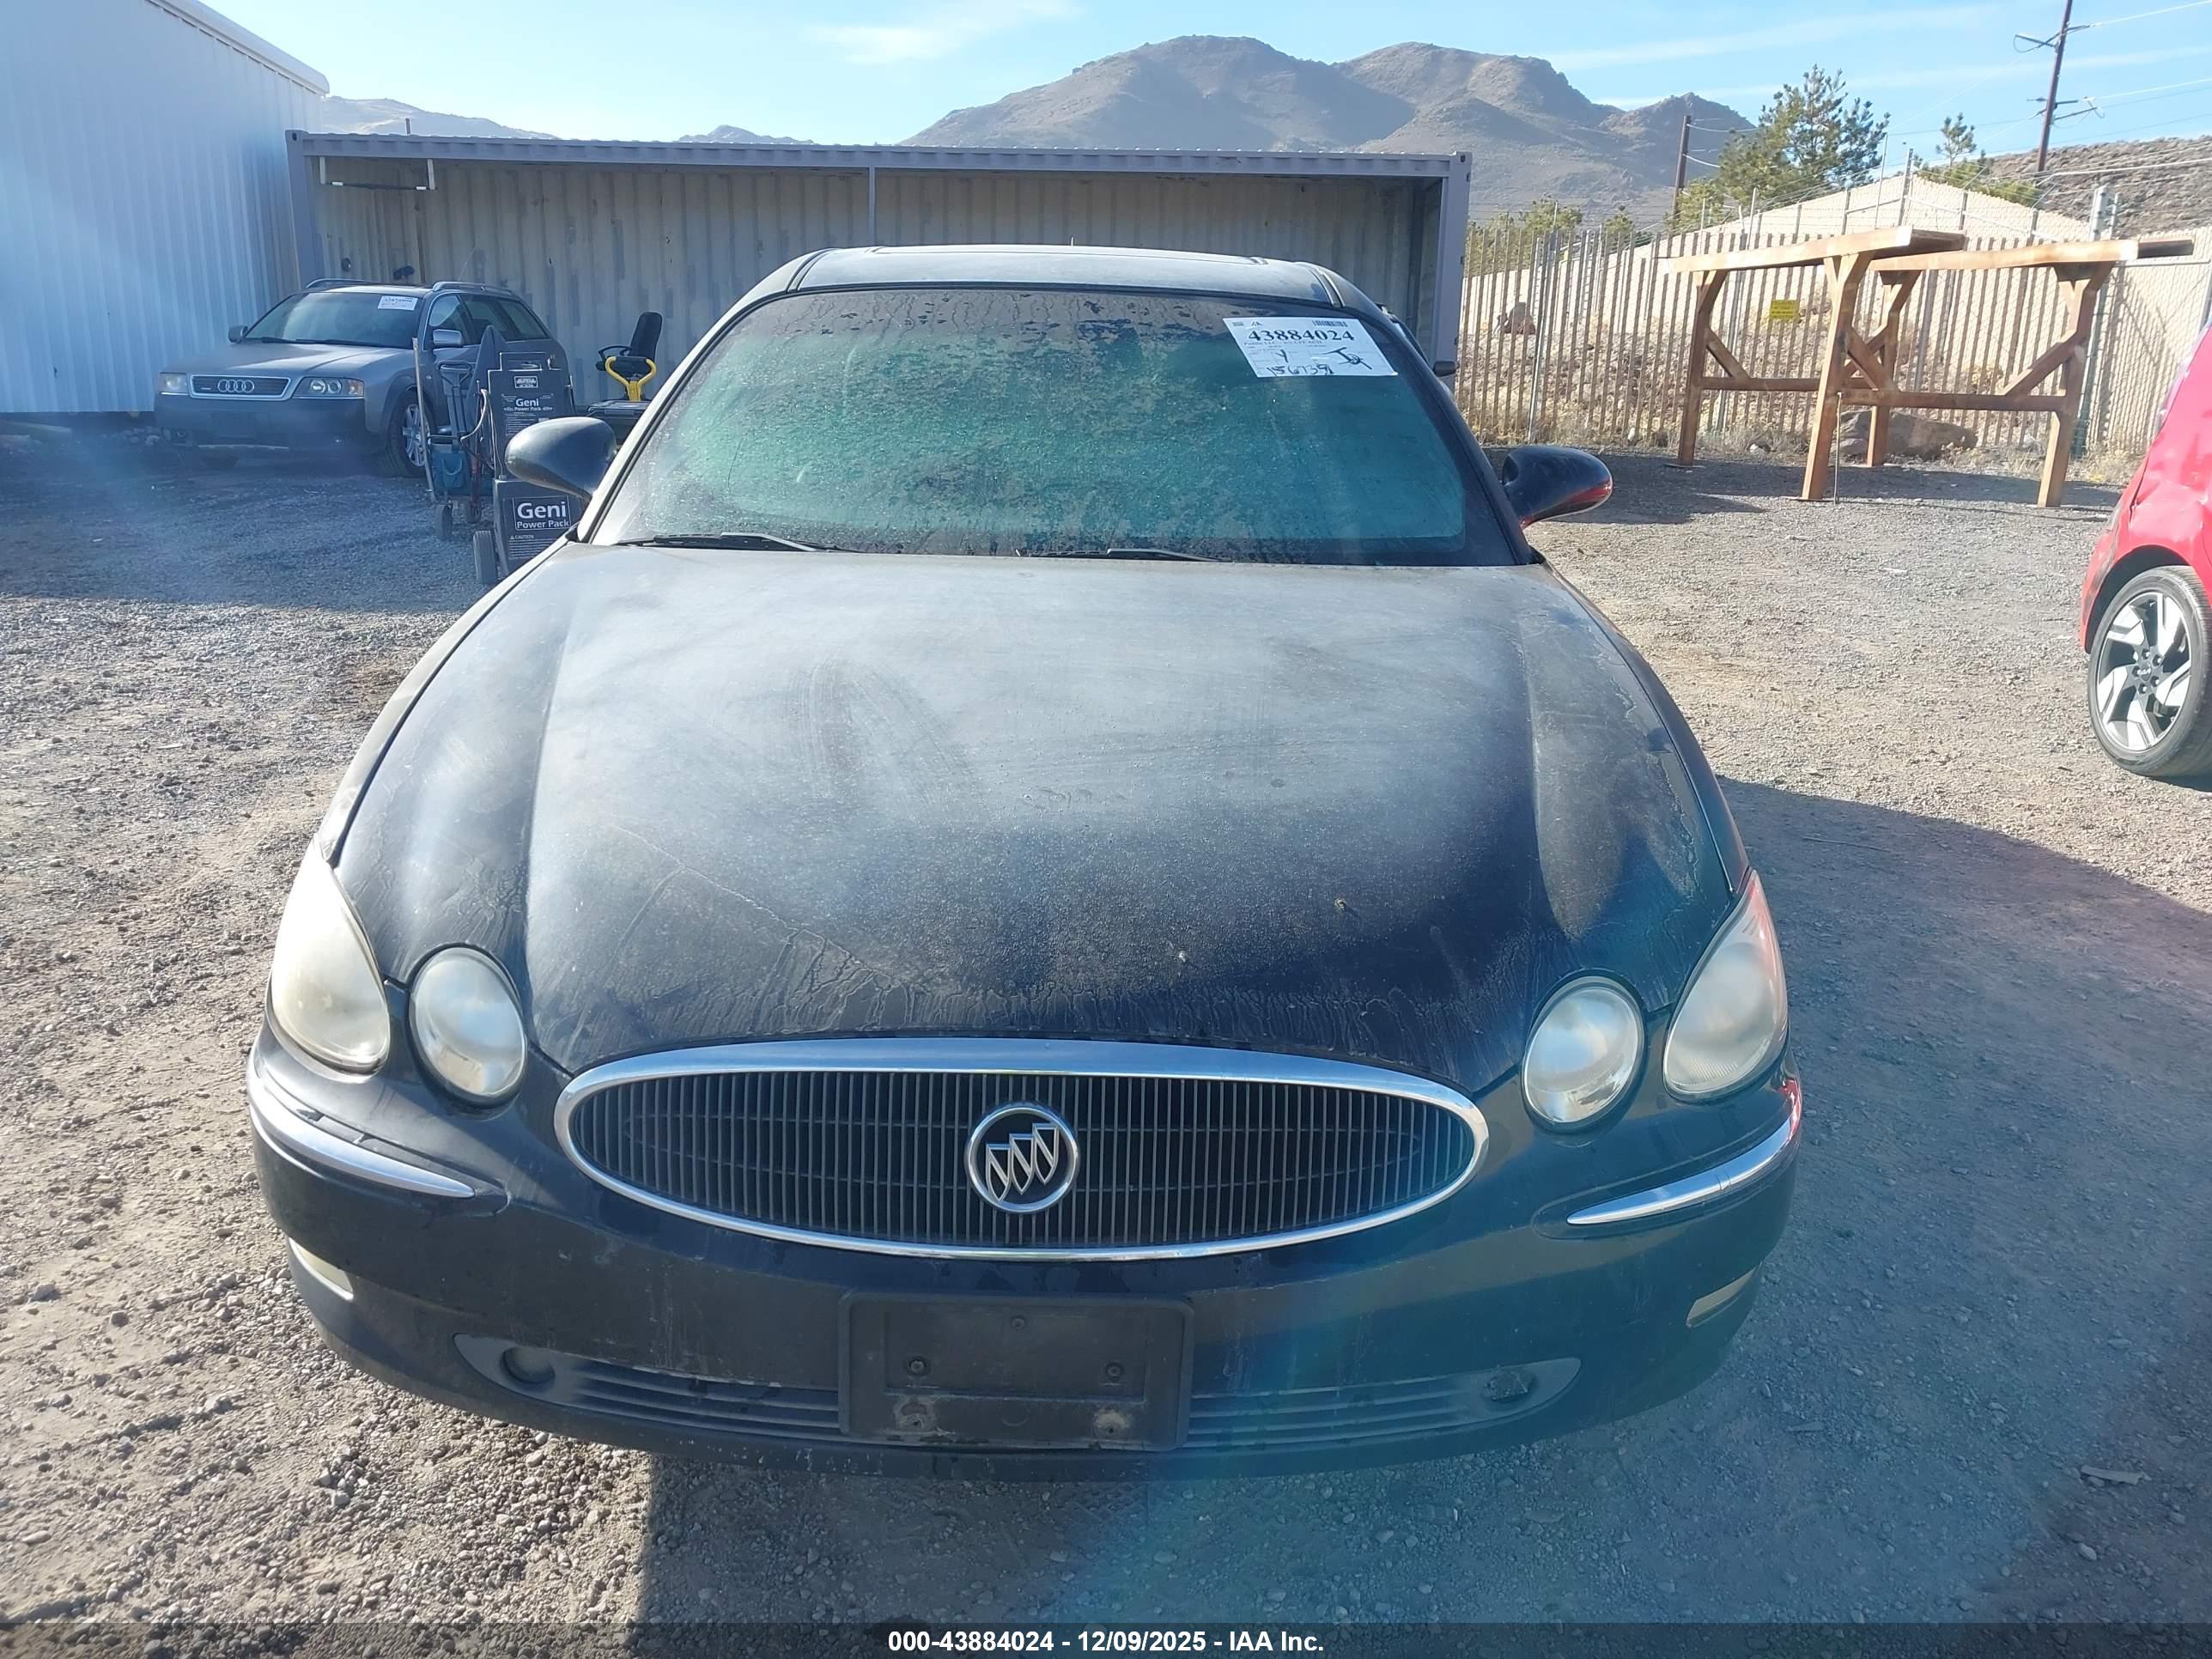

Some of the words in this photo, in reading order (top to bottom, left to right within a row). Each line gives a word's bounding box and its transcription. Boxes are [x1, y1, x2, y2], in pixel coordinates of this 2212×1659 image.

[1248, 329, 1354, 342] 43884024
[515, 398, 539, 407] Geni
[517, 501, 567, 520] Geni
[516, 520, 546, 529] Power
[548, 519, 570, 527] Pack
